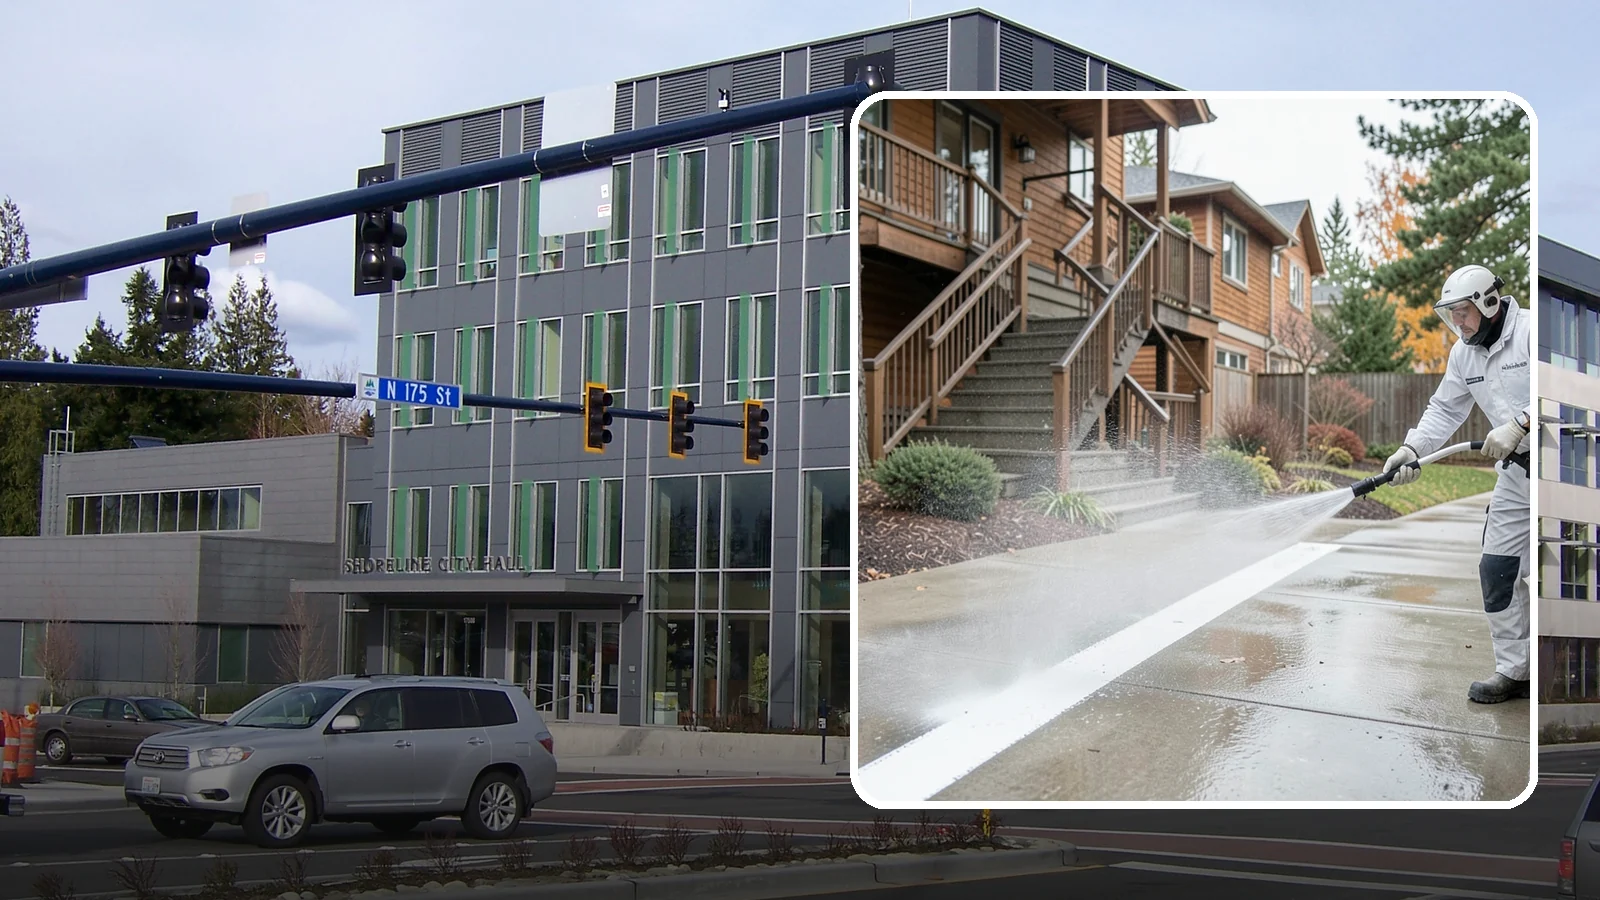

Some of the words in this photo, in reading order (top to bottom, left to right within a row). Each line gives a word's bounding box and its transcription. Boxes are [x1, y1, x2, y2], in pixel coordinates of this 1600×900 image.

[387, 380, 396, 399] N
[405, 382, 428, 403] 175
[436, 386, 452, 406] St
[345, 556, 432, 574] SHORELINE
[438, 556, 476, 573] CITY
[484, 555, 525, 571] HALL
